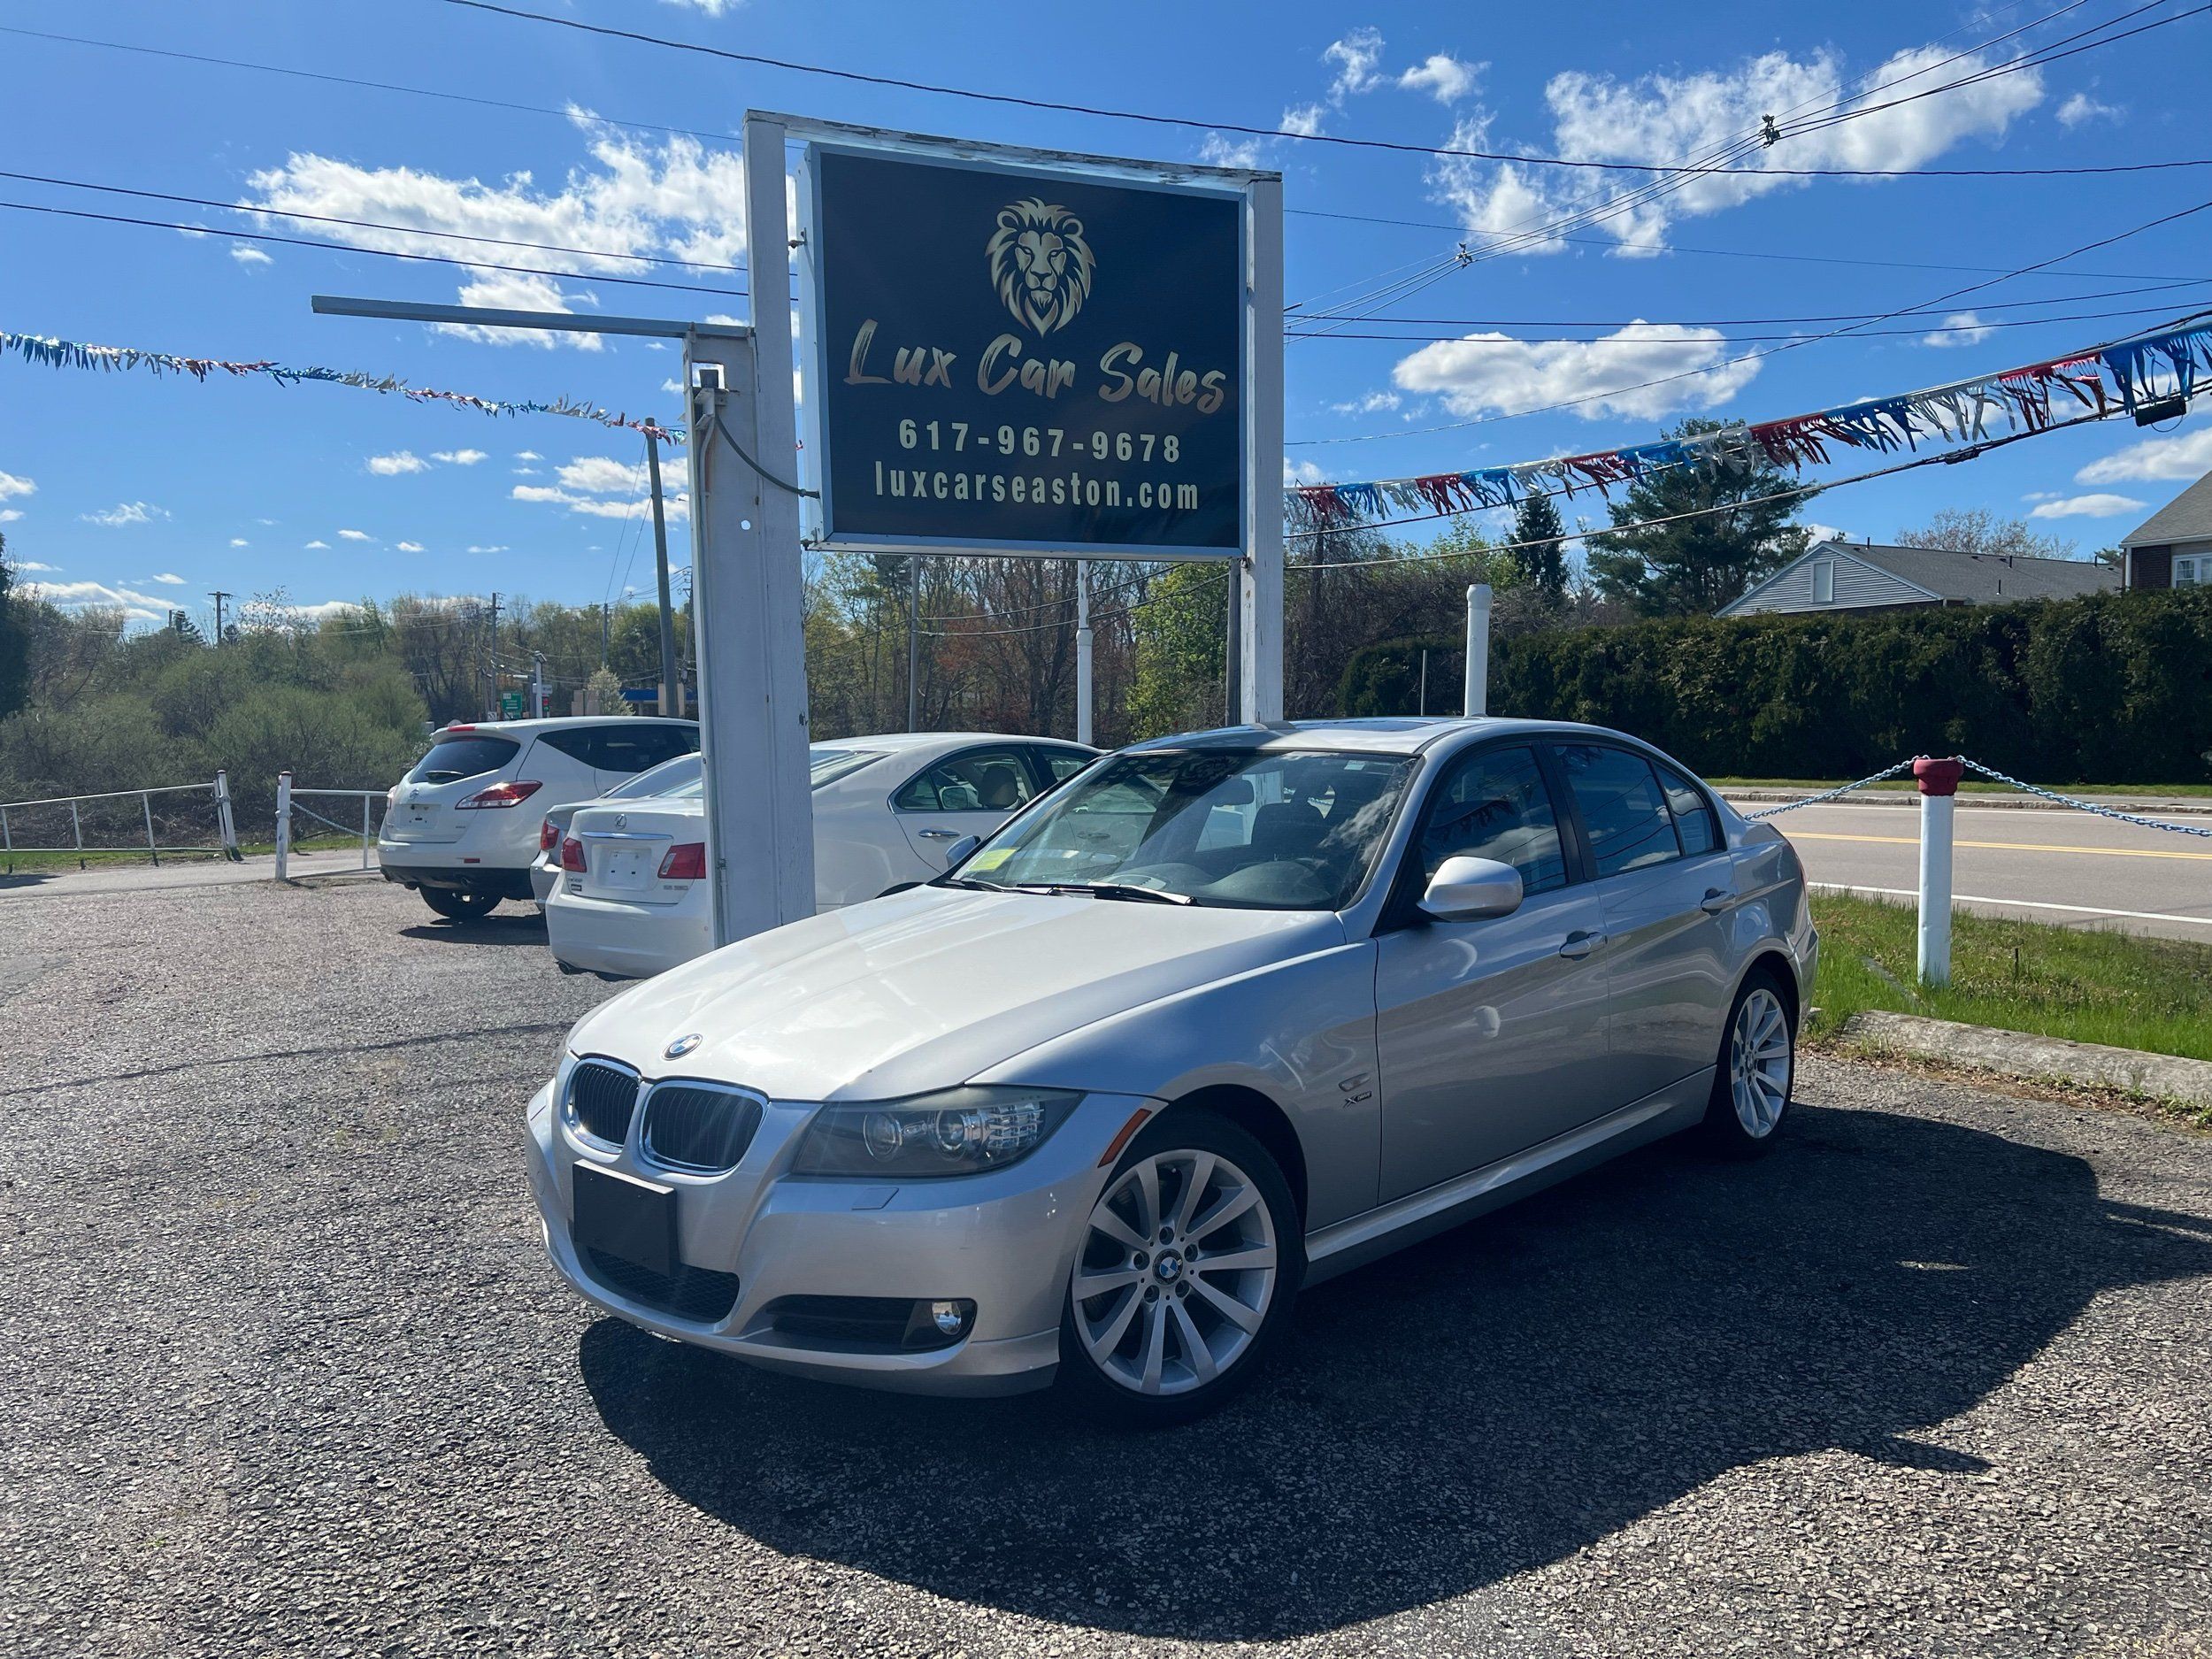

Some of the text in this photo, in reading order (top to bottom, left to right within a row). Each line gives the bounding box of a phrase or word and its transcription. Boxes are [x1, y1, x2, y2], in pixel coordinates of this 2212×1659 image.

[842, 319, 1226, 414] Lux Car Sales
[898, 419, 1180, 463] 617-967-9678
[874, 461, 1199, 511] luxcarseaston.com
